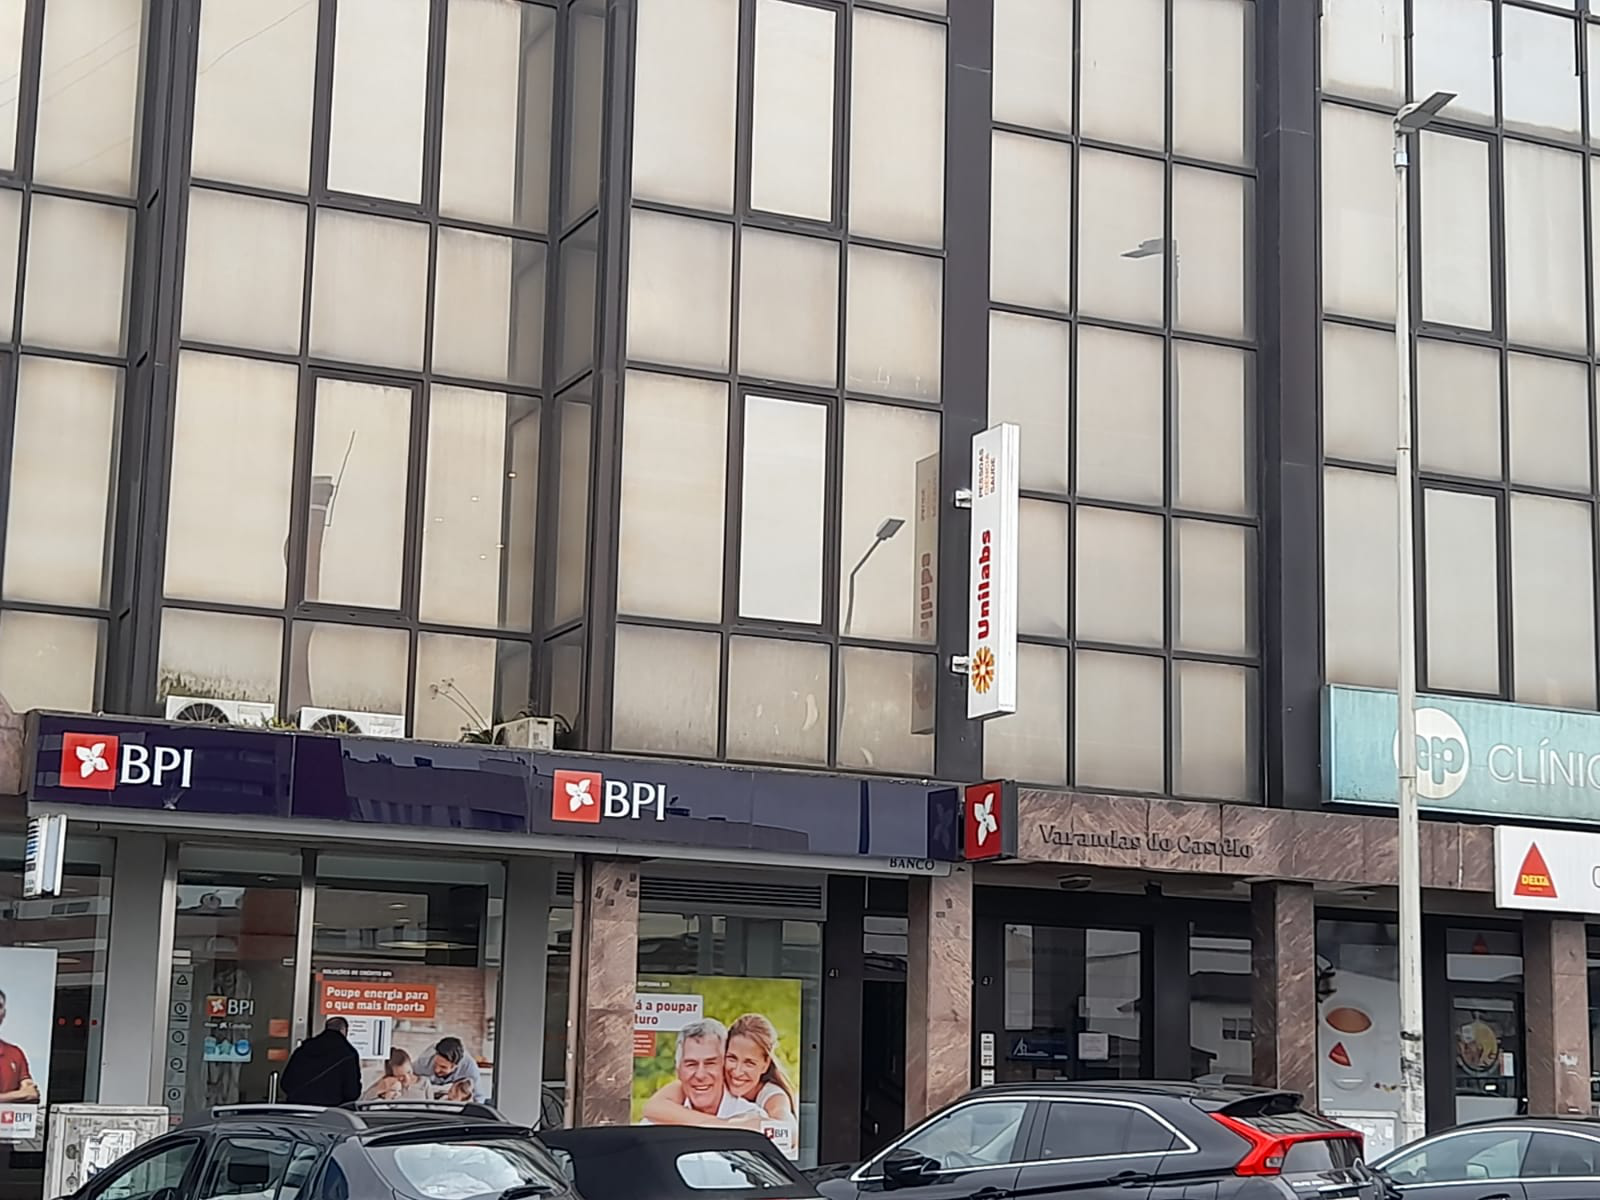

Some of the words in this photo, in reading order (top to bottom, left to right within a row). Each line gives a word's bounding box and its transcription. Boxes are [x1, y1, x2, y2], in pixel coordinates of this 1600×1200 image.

[977, 528, 992, 640] Unilabs
[120, 743, 194, 788] BPI
[603, 779, 667, 821] BPI
[1038, 823, 1141, 850] Varandas
[1146, 832, 1173, 853] do
[889, 857, 935, 871] BANCO
[829, 968, 840, 978] 41
[326, 986, 361, 999] Poupe
[364, 988, 403, 1001] energia
[405, 990, 429, 1001] para
[227, 999, 254, 1016] BPI
[325, 1001, 333, 1009] o
[334, 1001, 355, 1010] que
[356, 1001, 382, 1011] mais
[384, 1001, 425, 1012] importa
[645, 1002, 653, 1010] a
[656, 1002, 698, 1014] poupar
[15, 1112, 32, 1122] BPI
[774, 1128, 789, 1138] BPI
